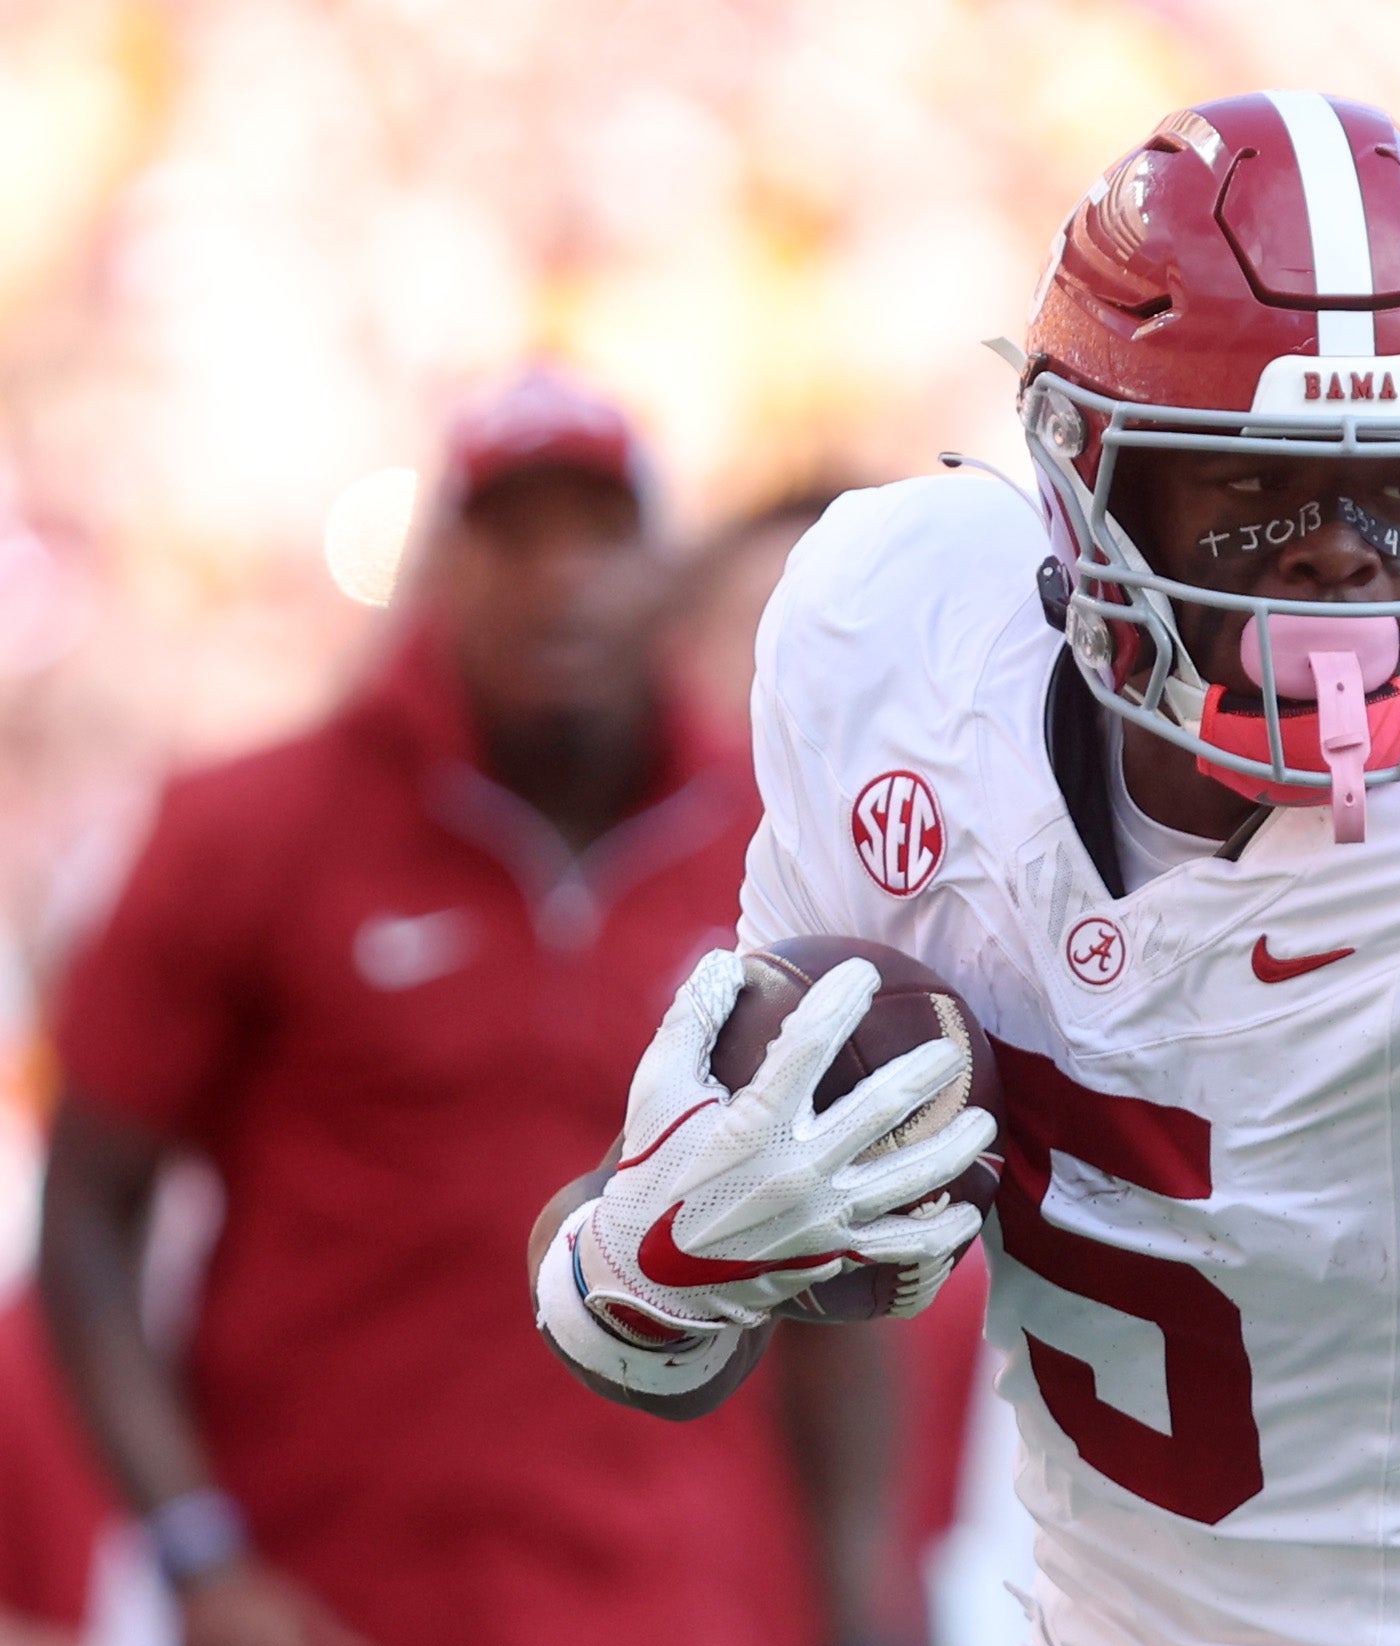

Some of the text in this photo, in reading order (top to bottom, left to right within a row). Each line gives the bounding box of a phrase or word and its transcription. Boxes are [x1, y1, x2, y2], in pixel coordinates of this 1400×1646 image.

[1304, 371, 1398, 400] BAMA
[856, 775, 937, 890] SEC
[985, 1028, 1264, 1526] 5
